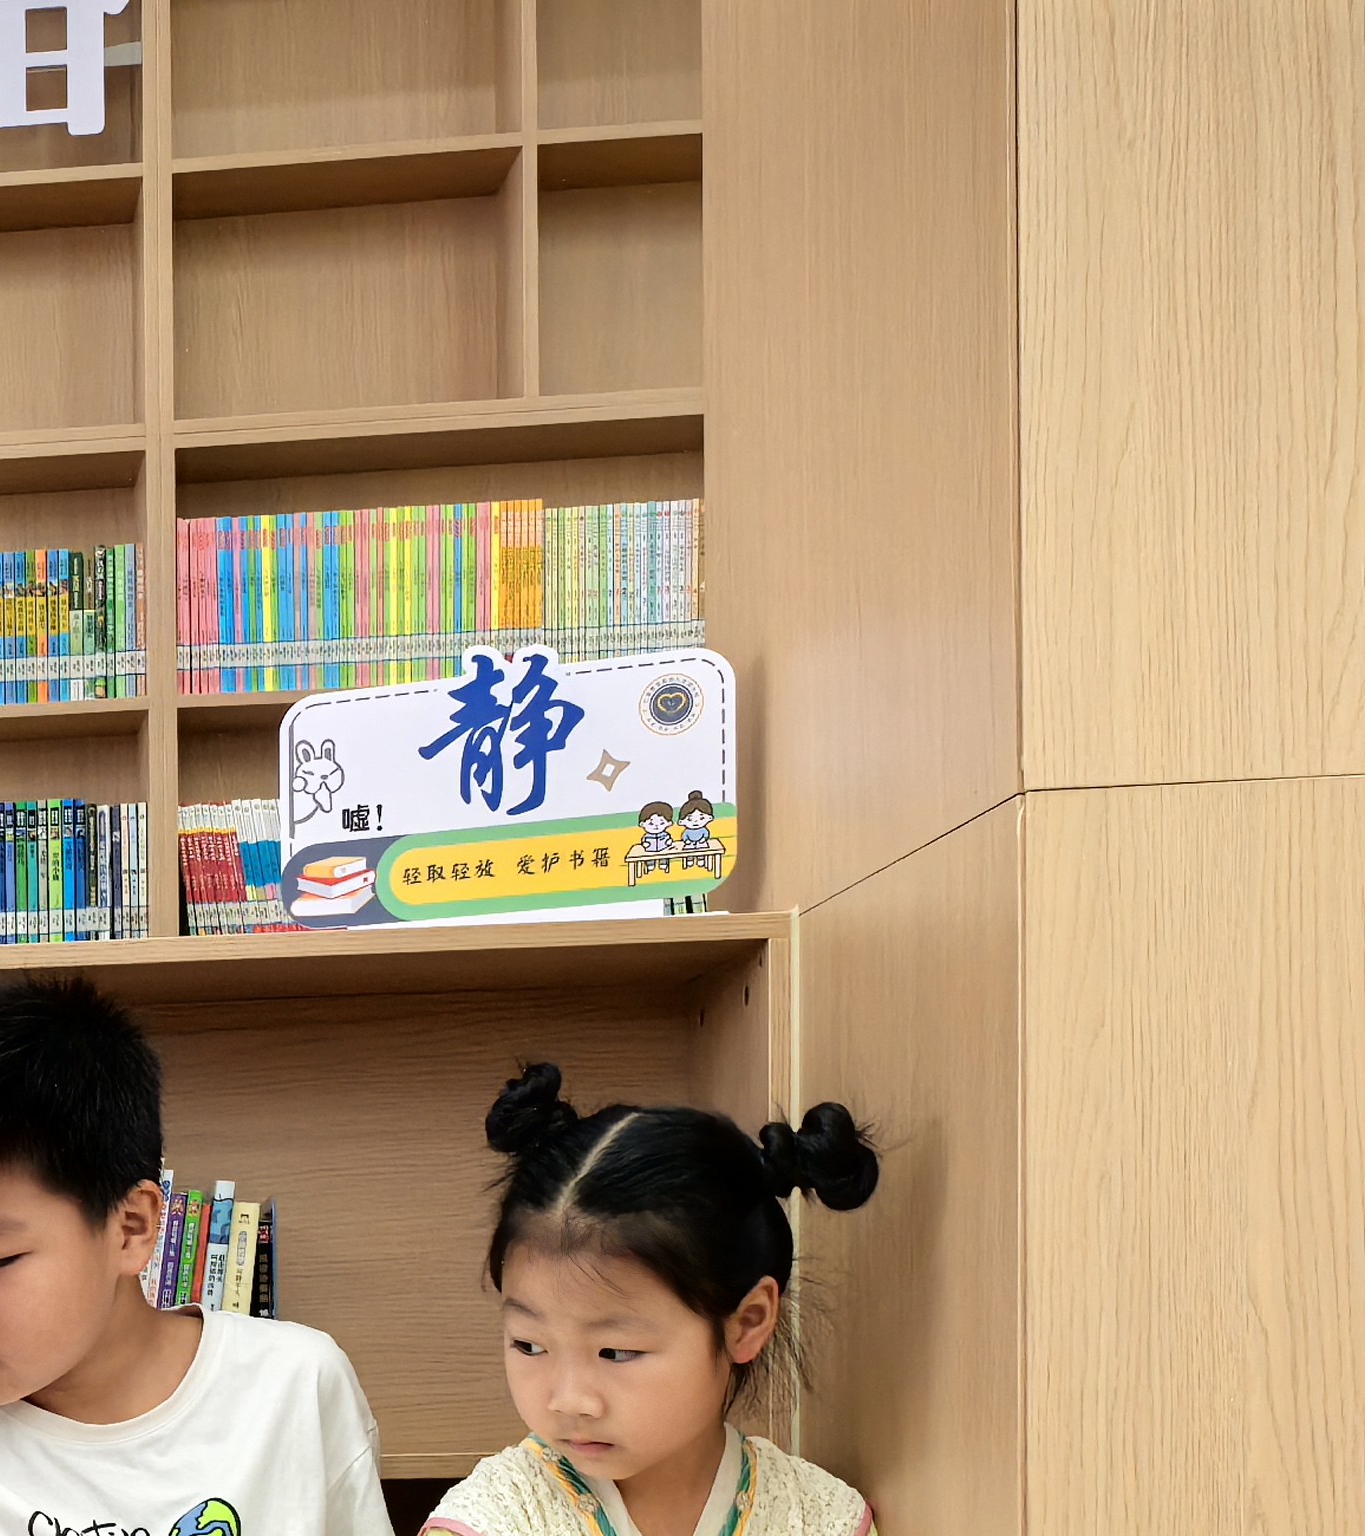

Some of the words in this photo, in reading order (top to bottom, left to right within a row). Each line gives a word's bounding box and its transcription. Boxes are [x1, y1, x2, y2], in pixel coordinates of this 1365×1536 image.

[418, 653, 585, 815] 静
[402, 857, 496, 886] 轻取轻放
[516, 846, 612, 876] 爱护书籍
